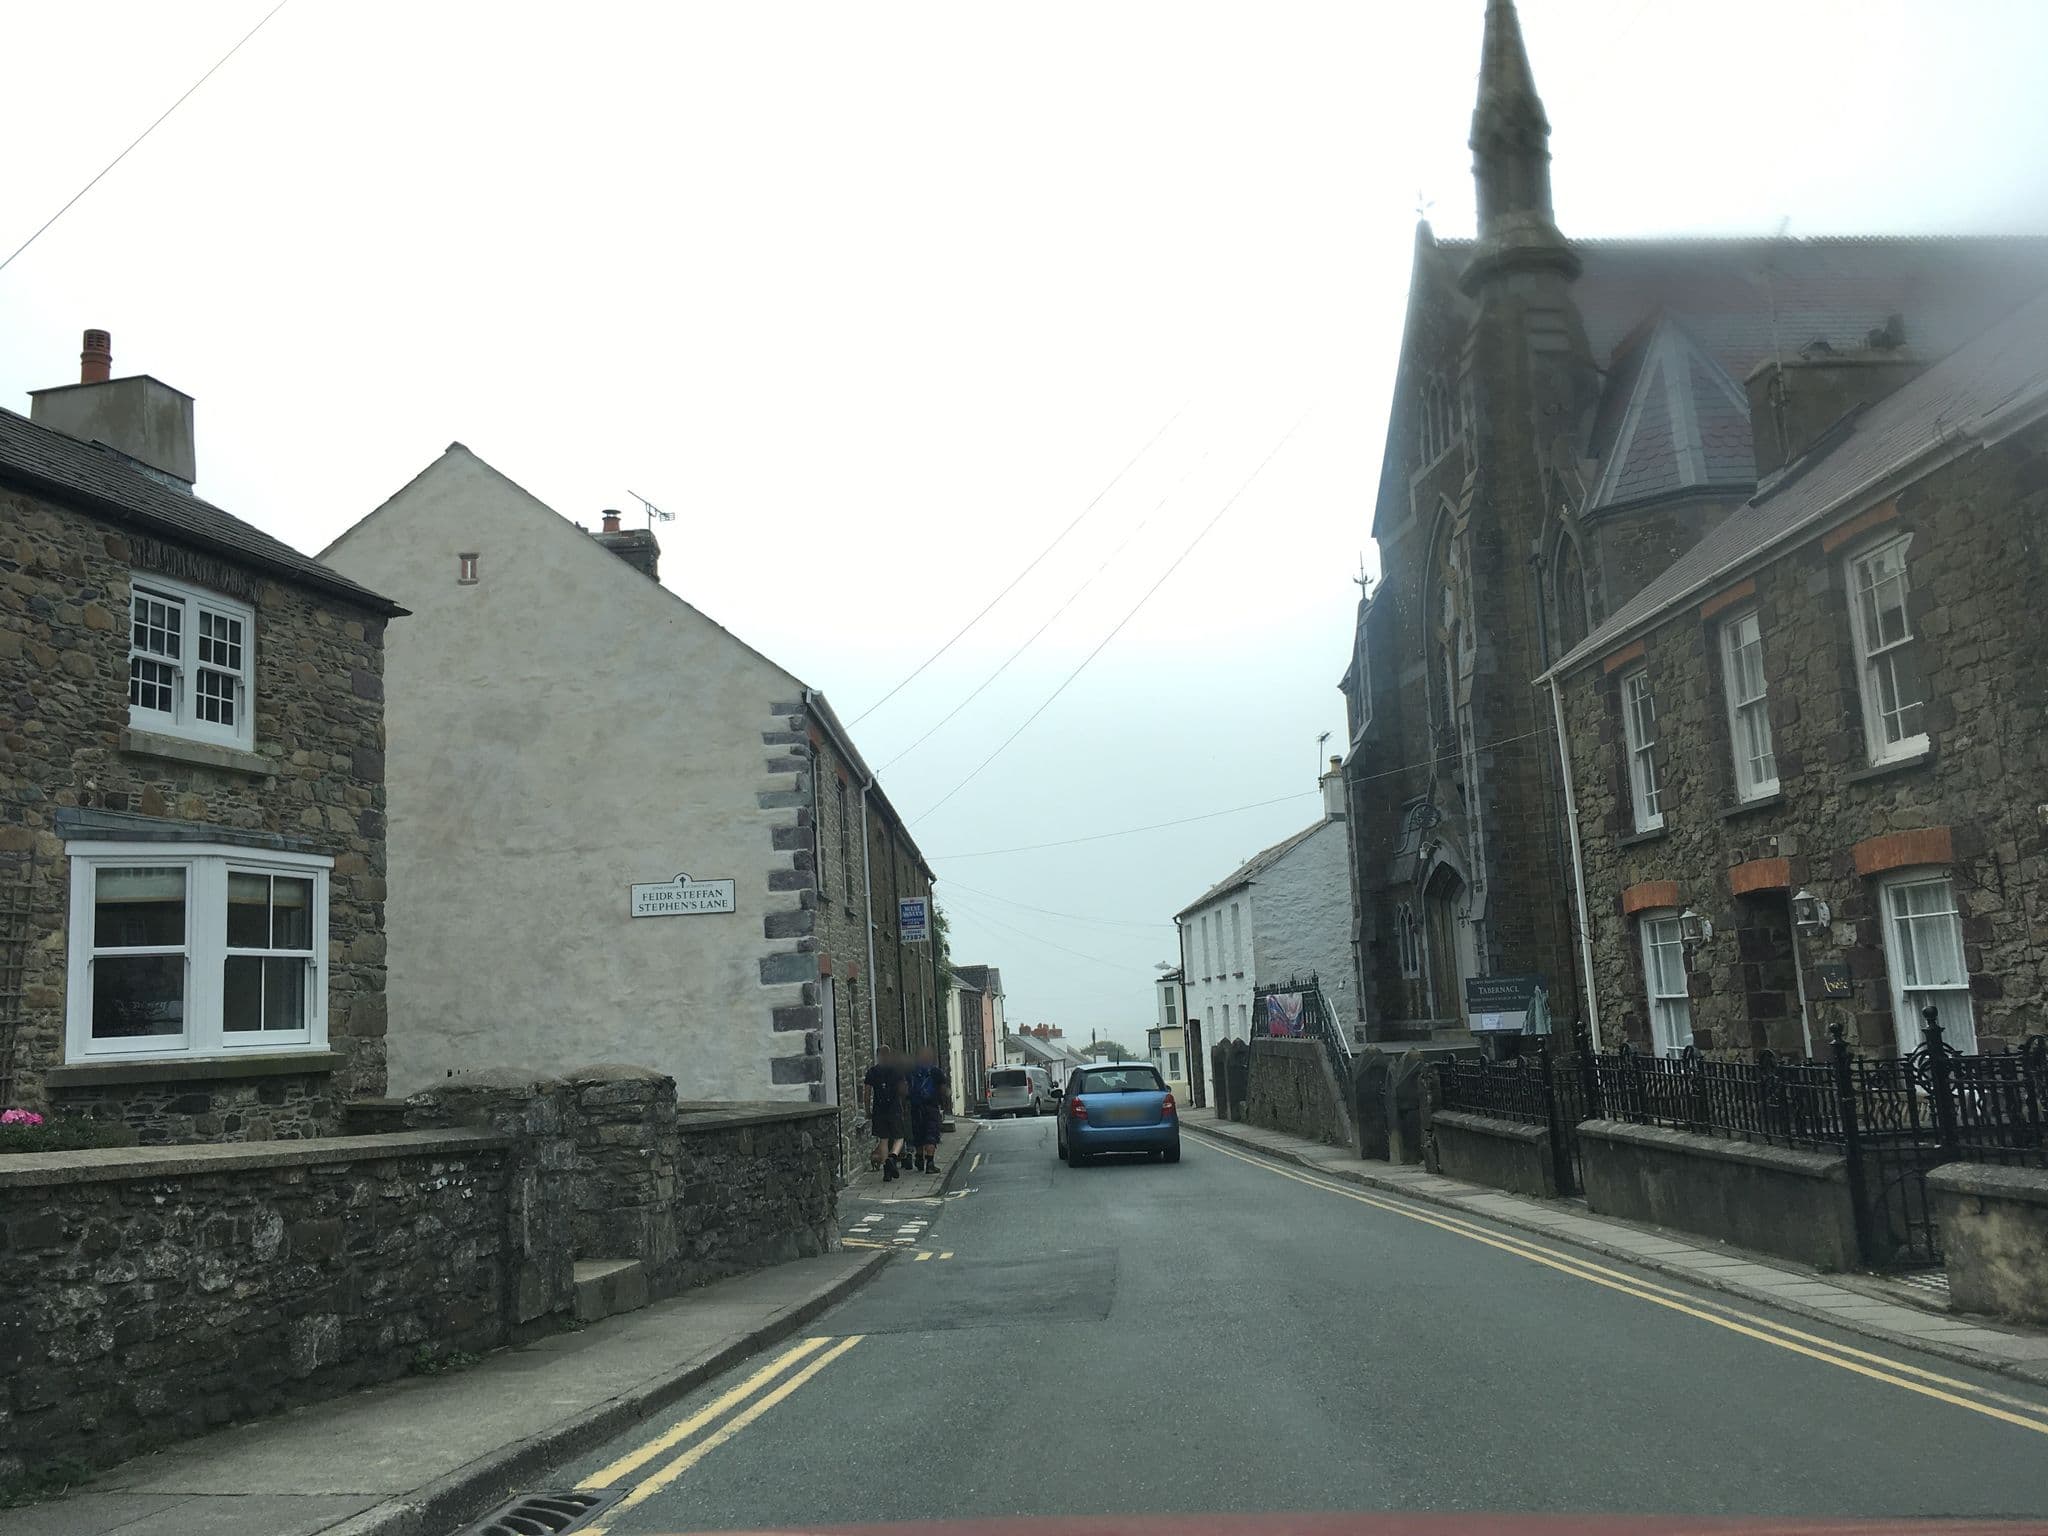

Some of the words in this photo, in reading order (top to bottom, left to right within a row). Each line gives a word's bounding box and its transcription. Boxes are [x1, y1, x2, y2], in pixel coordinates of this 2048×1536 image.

[642, 891, 674, 901] FEIDR
[676, 889, 723, 900] STEFFAN
[639, 900, 697, 912] STEPHEN'S
[700, 899, 728, 909] LANE
[1478, 985, 1520, 995] TABERNACL
